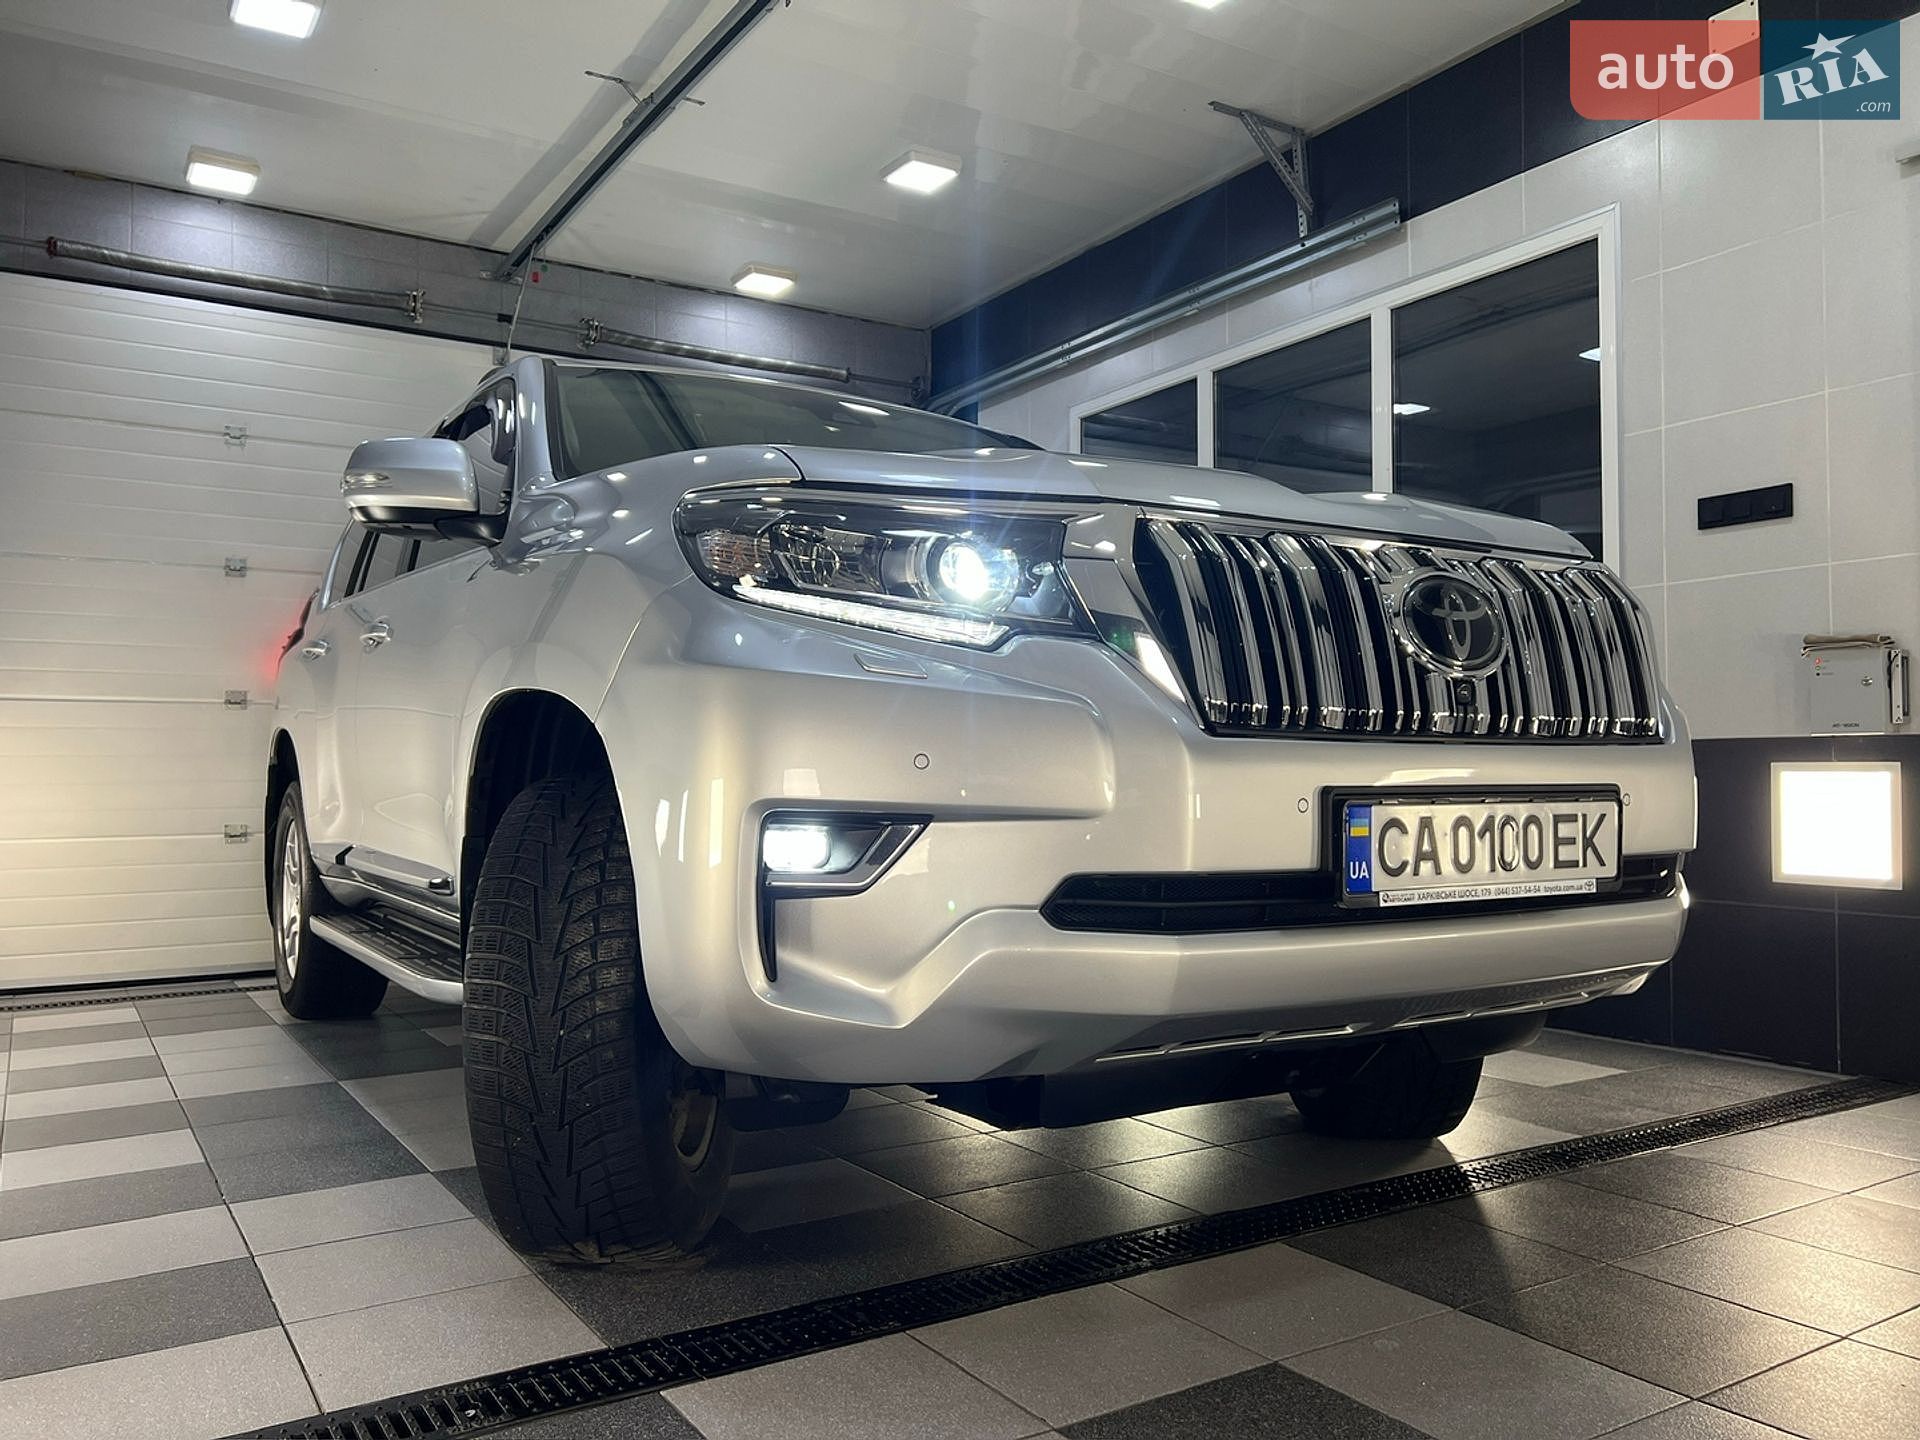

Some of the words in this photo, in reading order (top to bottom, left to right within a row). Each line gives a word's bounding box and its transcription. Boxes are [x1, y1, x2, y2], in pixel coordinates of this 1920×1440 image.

[1377, 815, 1442, 878] CA
[1450, 814, 1544, 874] 0100
[1552, 812, 1607, 869] EK
[1349, 861, 1369, 880] UA
